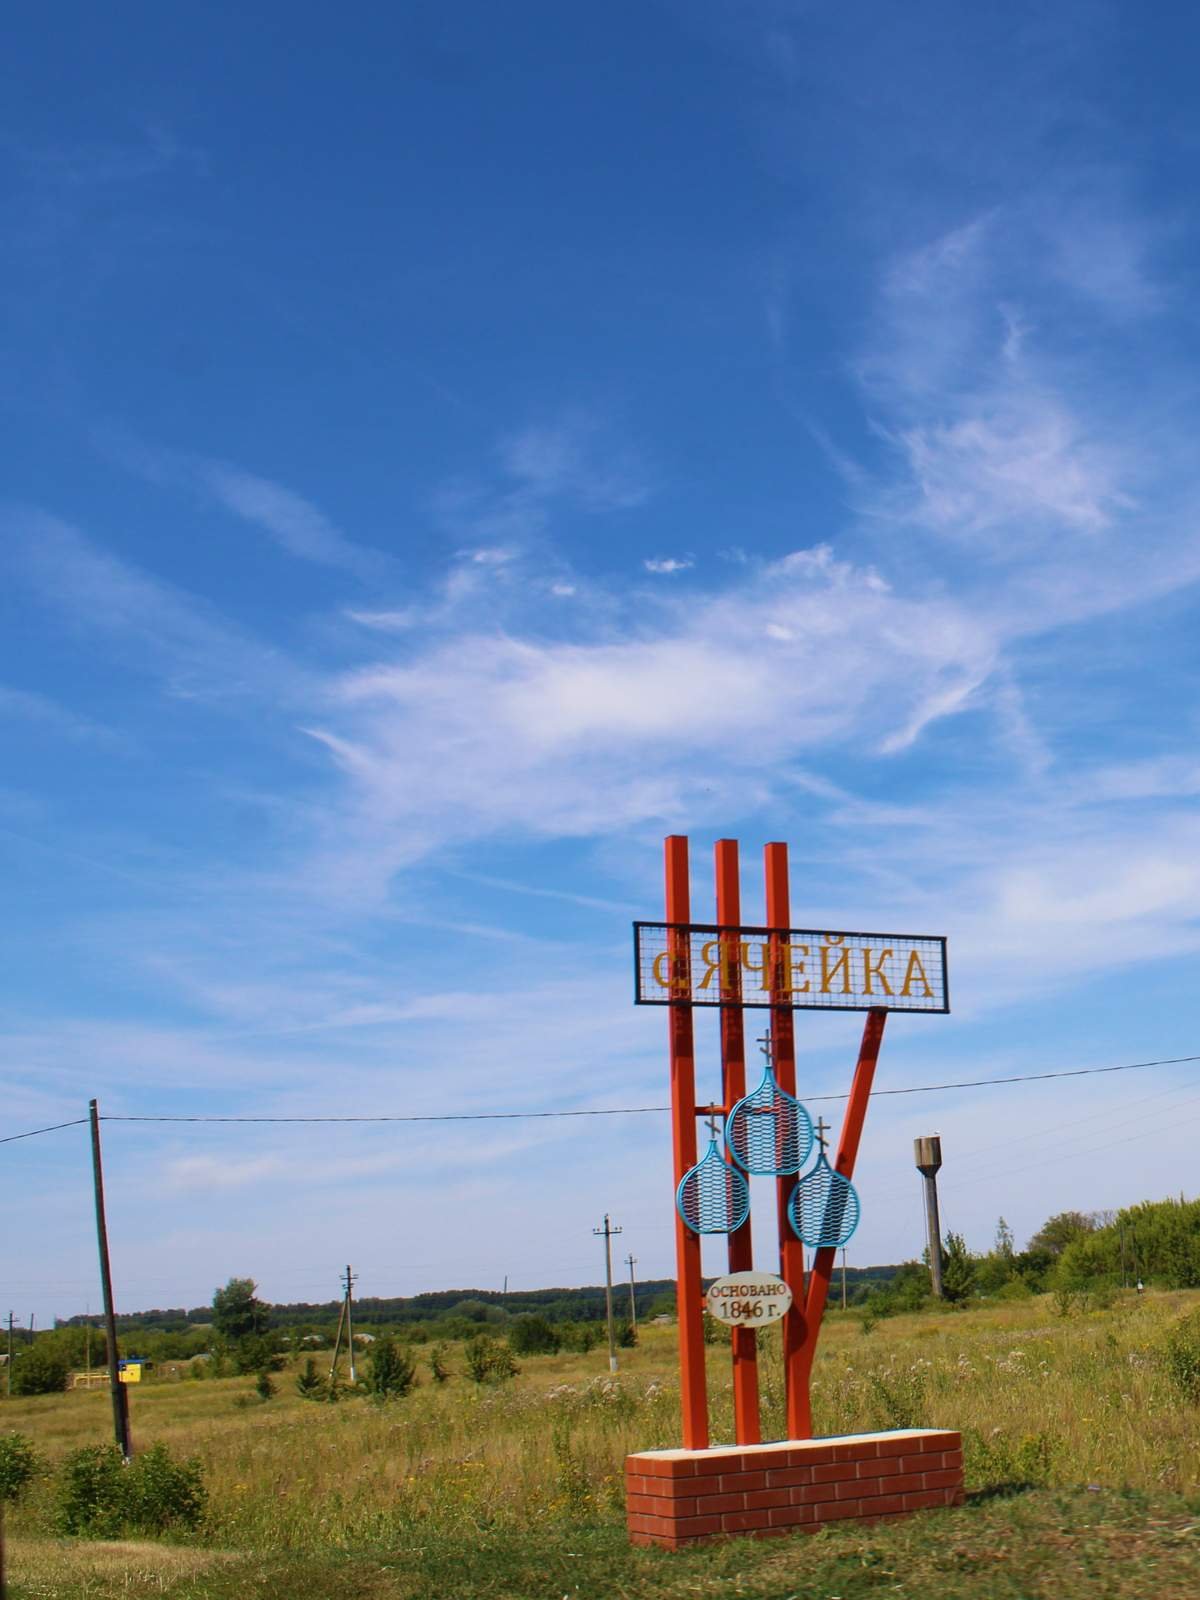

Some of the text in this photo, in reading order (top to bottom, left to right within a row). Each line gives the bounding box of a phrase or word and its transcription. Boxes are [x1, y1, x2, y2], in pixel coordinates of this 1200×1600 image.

[696, 935, 934, 997] ЯЧЕЙКА
[711, 1284, 786, 1297] ОСНОВАНО
[720, 1301, 763, 1319] 1846
